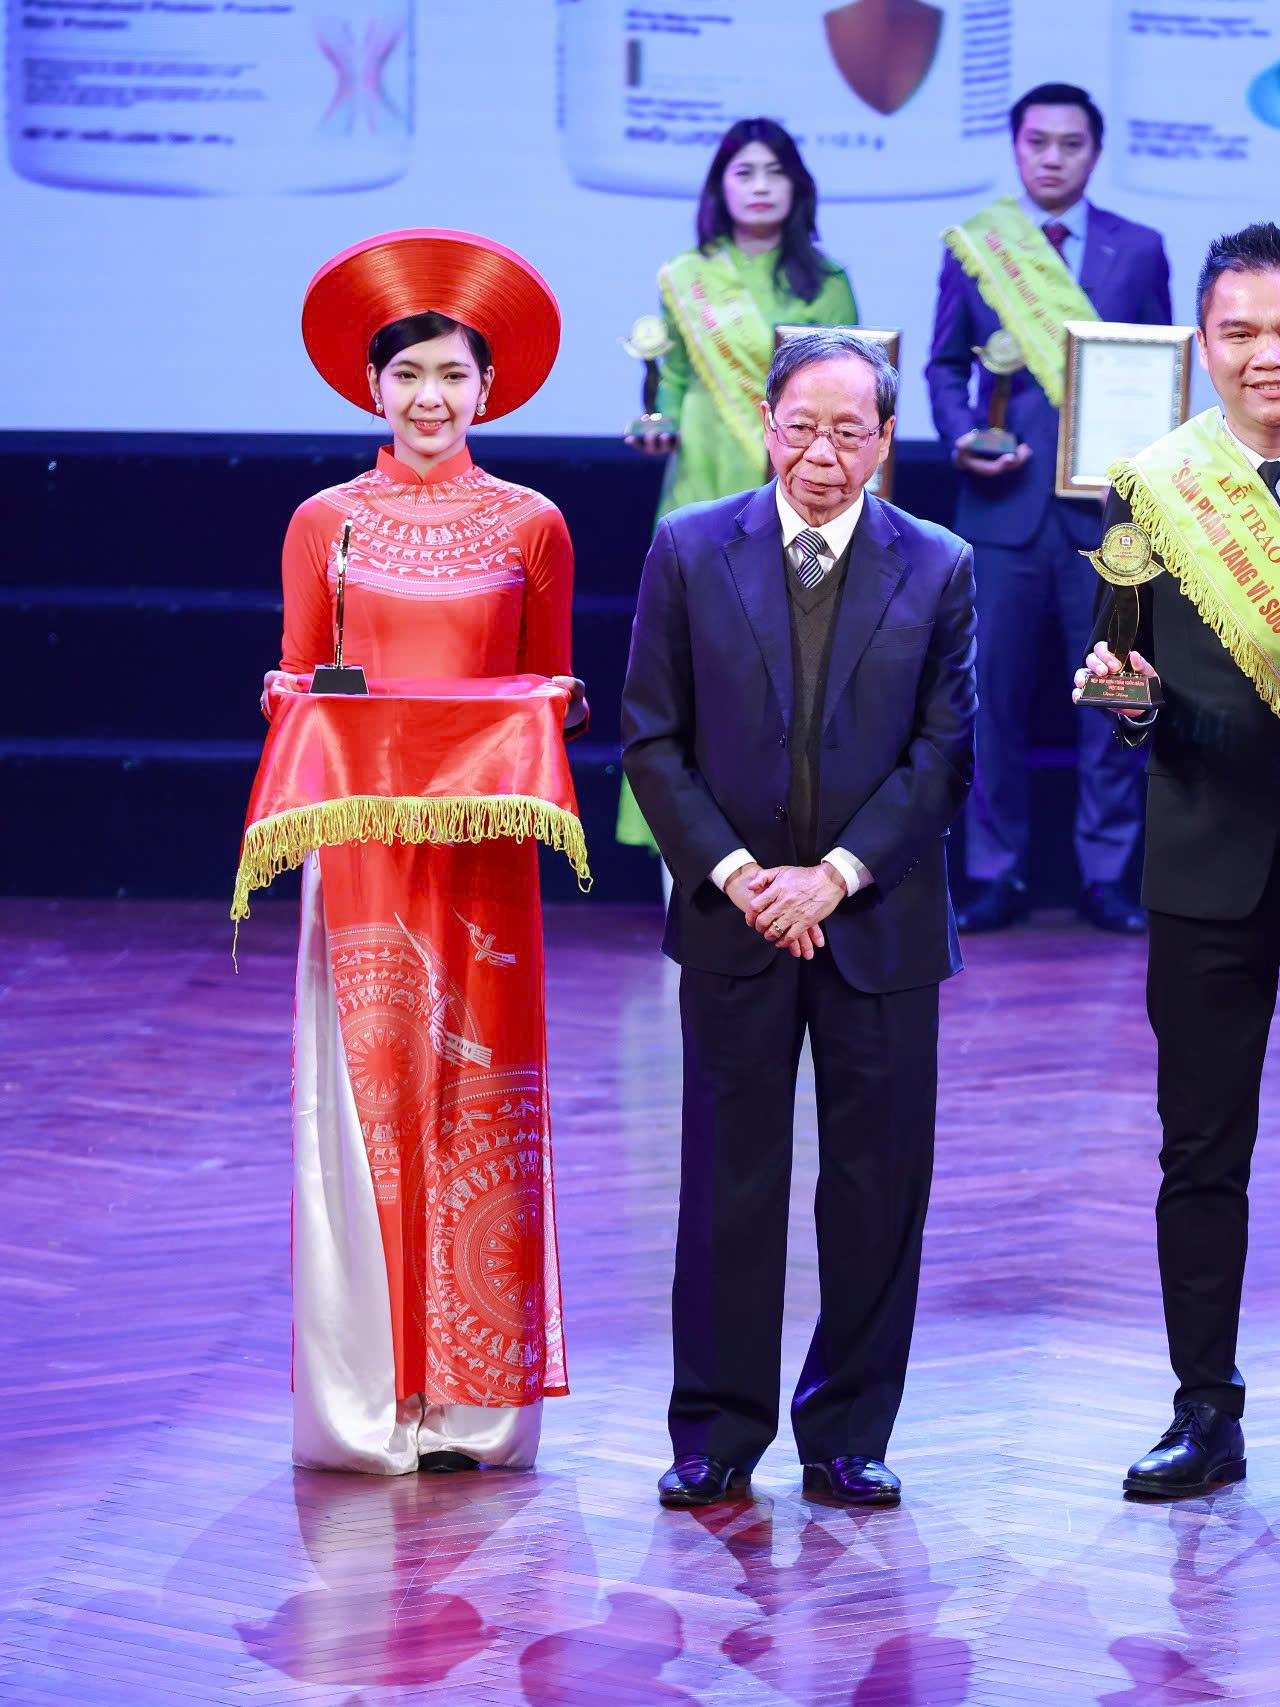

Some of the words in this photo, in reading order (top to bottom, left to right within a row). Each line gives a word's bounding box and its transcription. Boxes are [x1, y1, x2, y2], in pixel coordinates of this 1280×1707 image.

[1218, 472, 1254, 506] LỄ
[1190, 496, 1231, 546] PHẨM
[1219, 538, 1258, 587] VÀNG
[1246, 580, 1275, 604] VÌ
